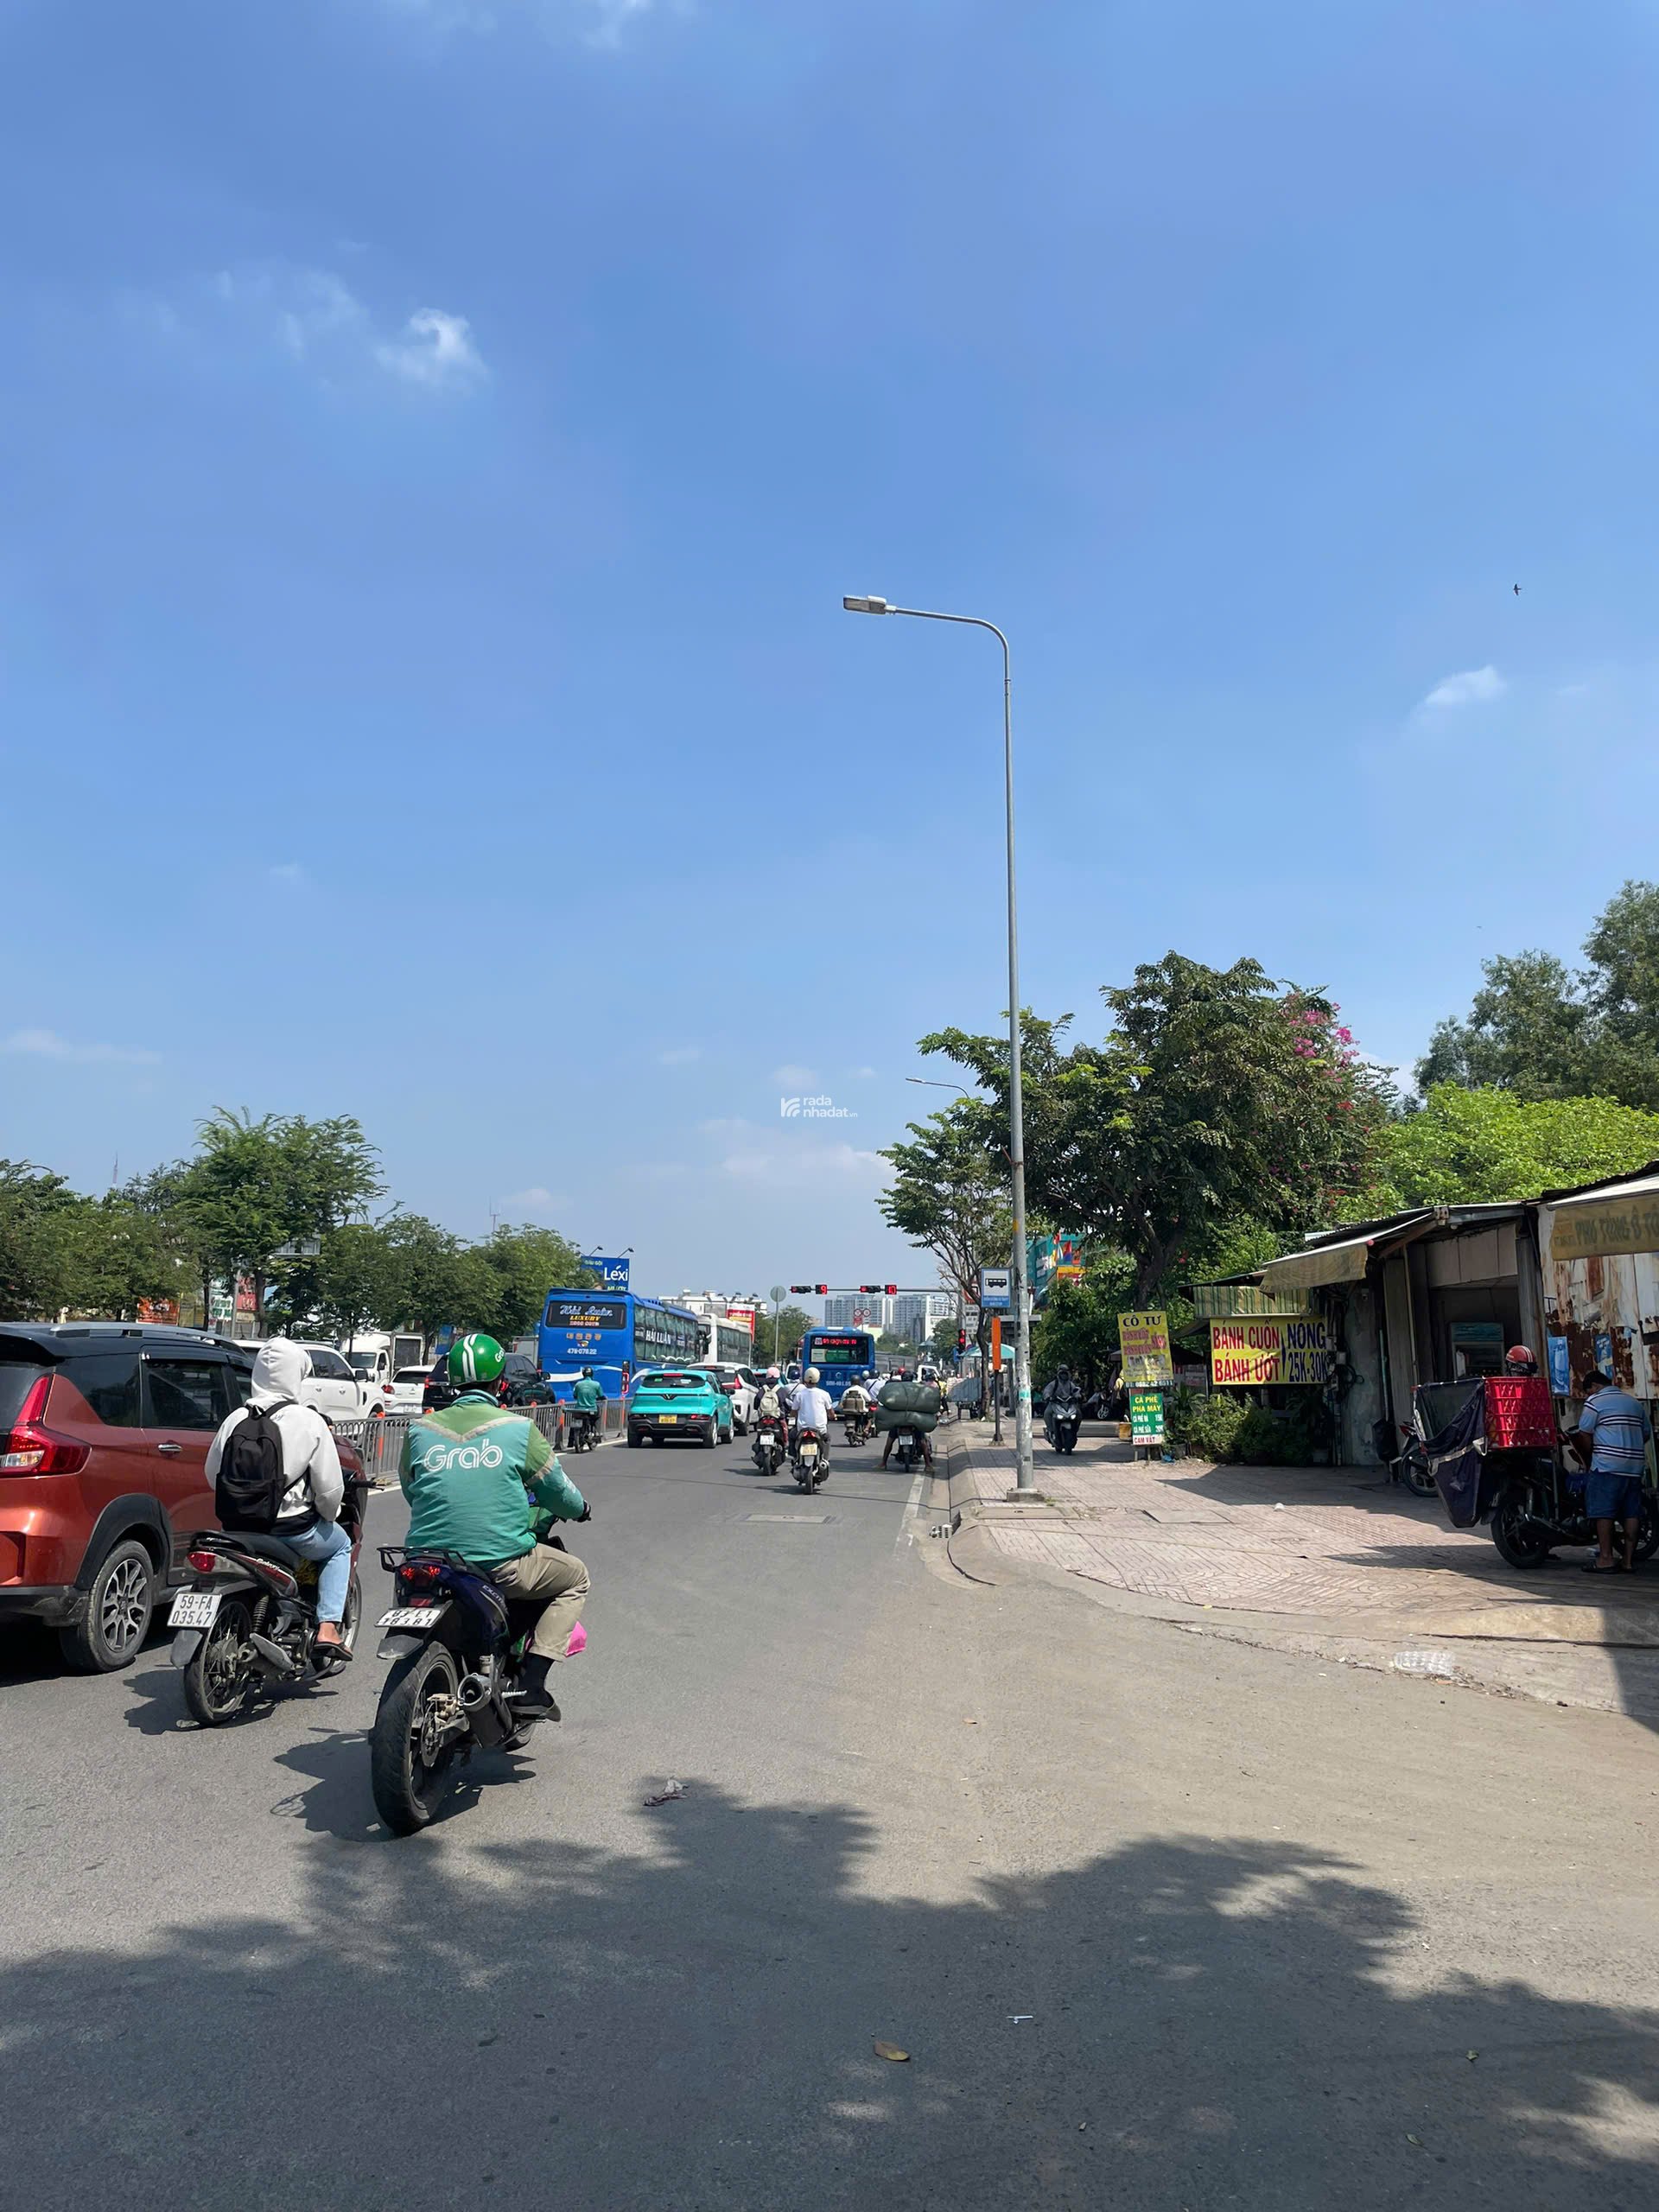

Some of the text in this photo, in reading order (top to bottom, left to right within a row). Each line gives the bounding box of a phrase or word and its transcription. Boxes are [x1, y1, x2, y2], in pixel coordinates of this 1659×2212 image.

[820, 1285, 827, 1294] 9
[1123, 1315, 1162, 1328] CÔ TƯ
[1287, 1316, 1327, 1349] NÓNG
[1212, 1319, 1280, 1350] BÁNH CUỐN
[1214, 1351, 1280, 1382] BÁNH ƯỚT
[423, 1438, 503, 1472] Grab
[180, 1595, 213, 1610] 59-FA
[171, 1610, 213, 1625] 035.47
